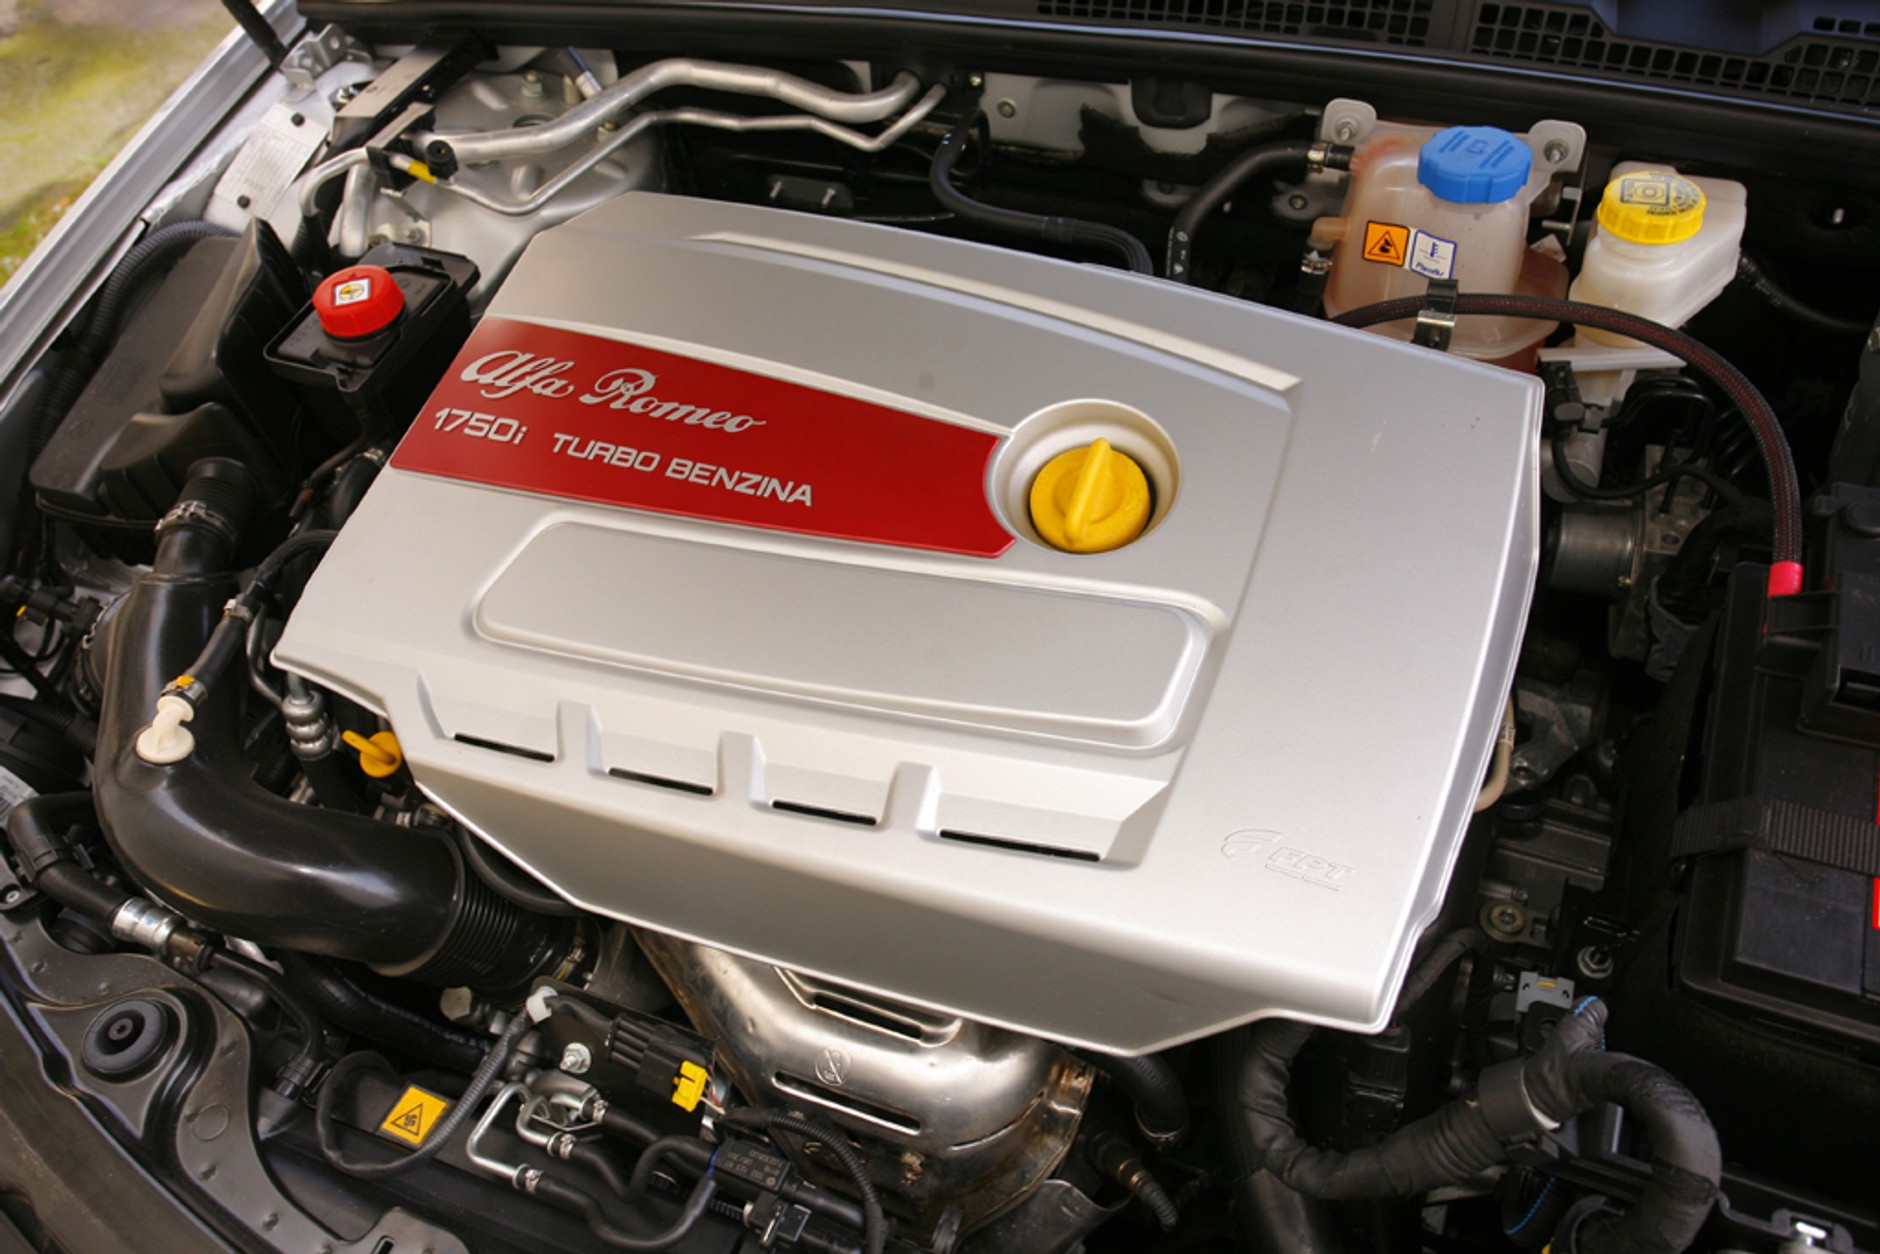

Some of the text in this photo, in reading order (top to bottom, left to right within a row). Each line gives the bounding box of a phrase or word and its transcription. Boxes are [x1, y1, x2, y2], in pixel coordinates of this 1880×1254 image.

[461, 350, 767, 432] Alfa Romeo
[434, 407, 813, 506] 1750i TURBO BENZINA
